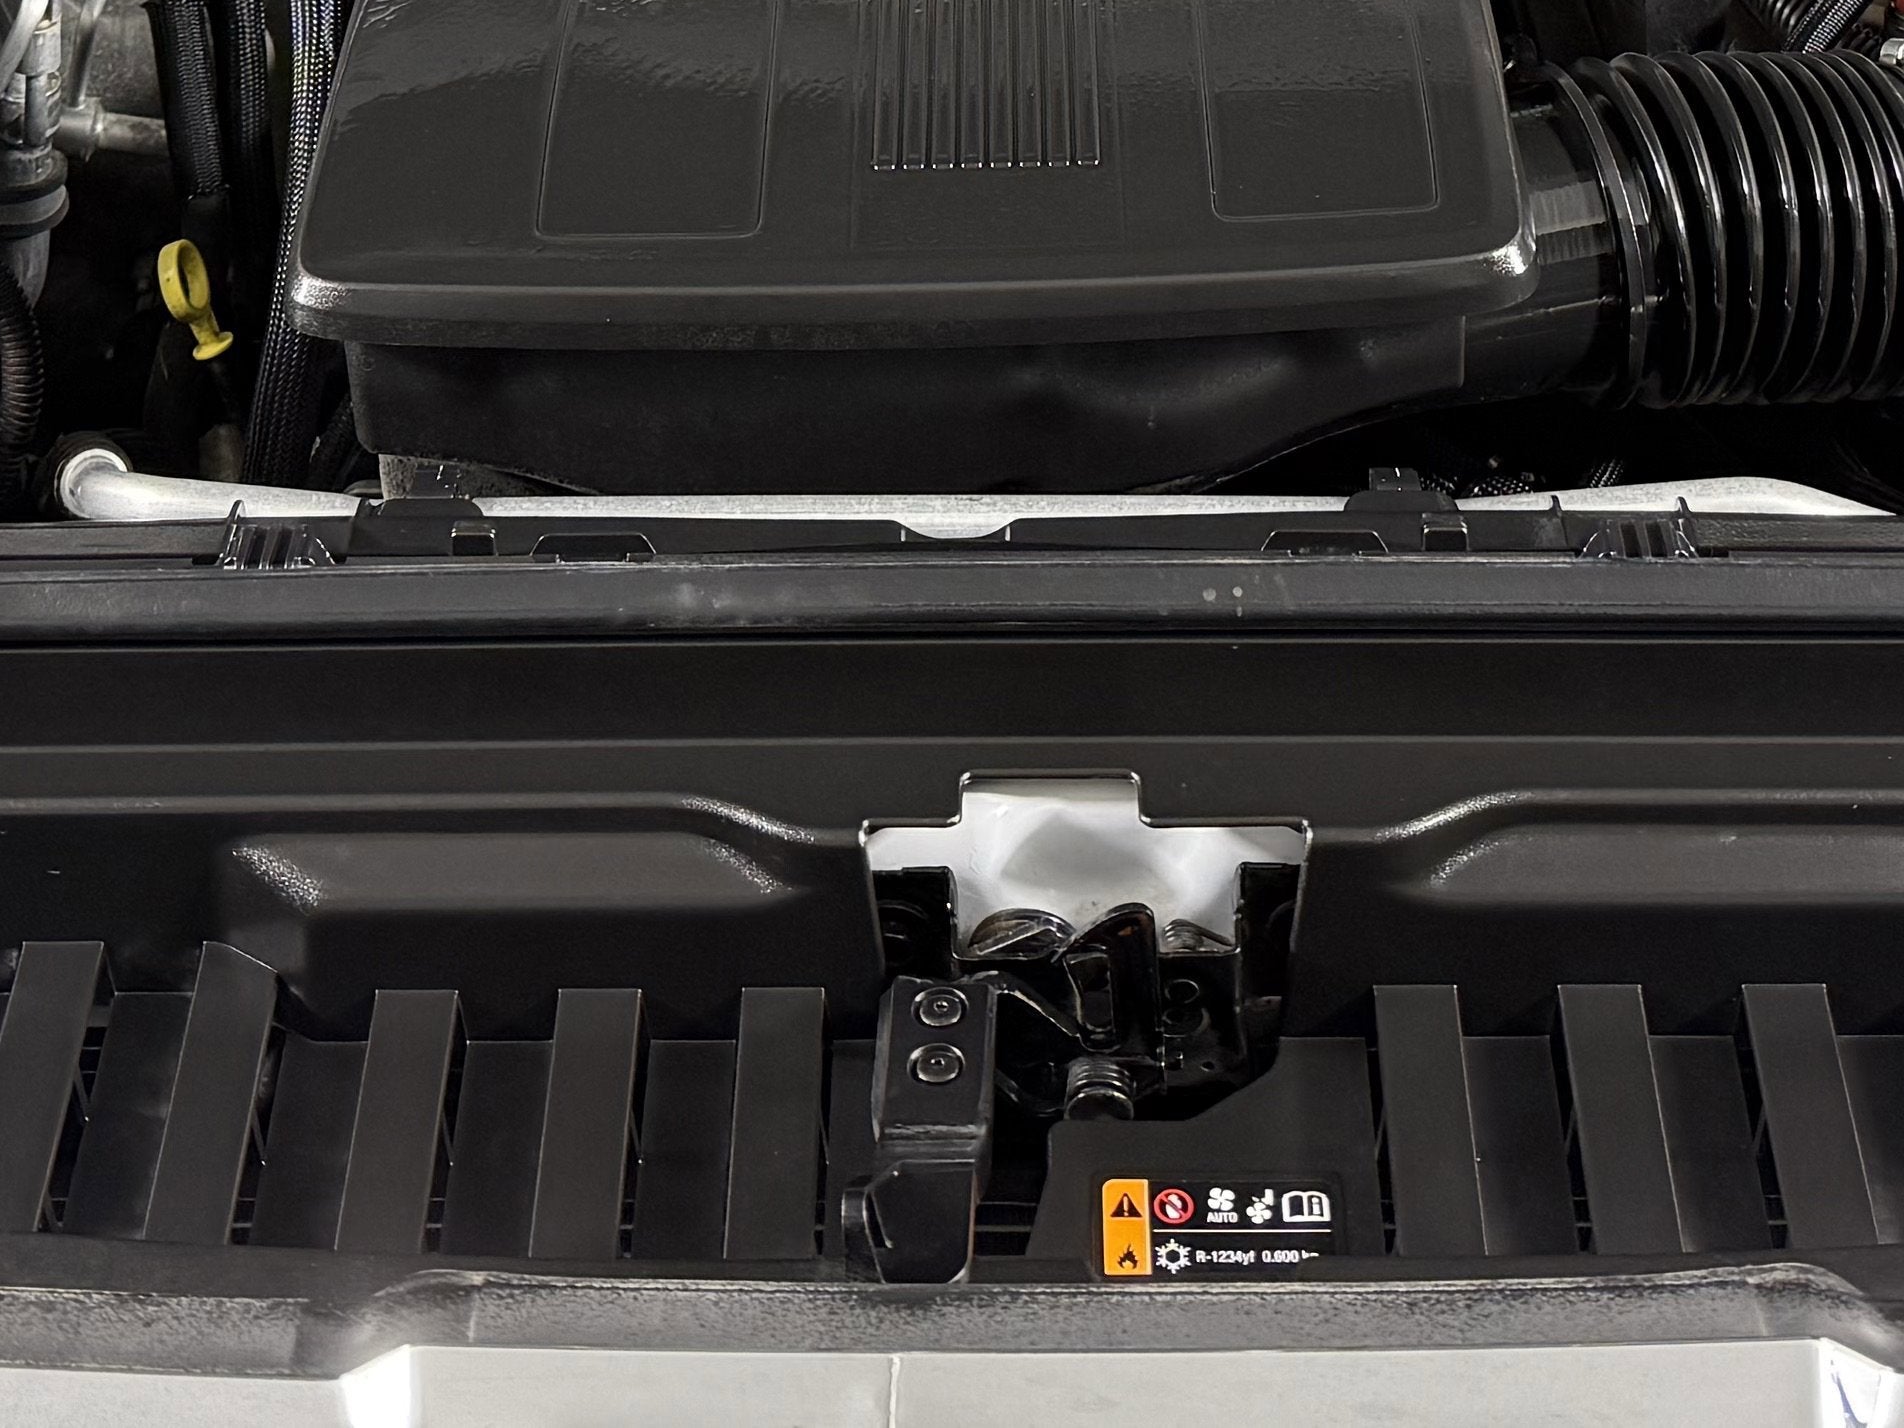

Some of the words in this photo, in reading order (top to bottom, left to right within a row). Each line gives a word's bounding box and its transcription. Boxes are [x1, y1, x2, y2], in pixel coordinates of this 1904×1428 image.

[1206, 1212, 1238, 1223] AUTO
[1195, 1250, 1255, 1265] R-1234yf
[1261, 1250, 1299, 1263] 0.600
